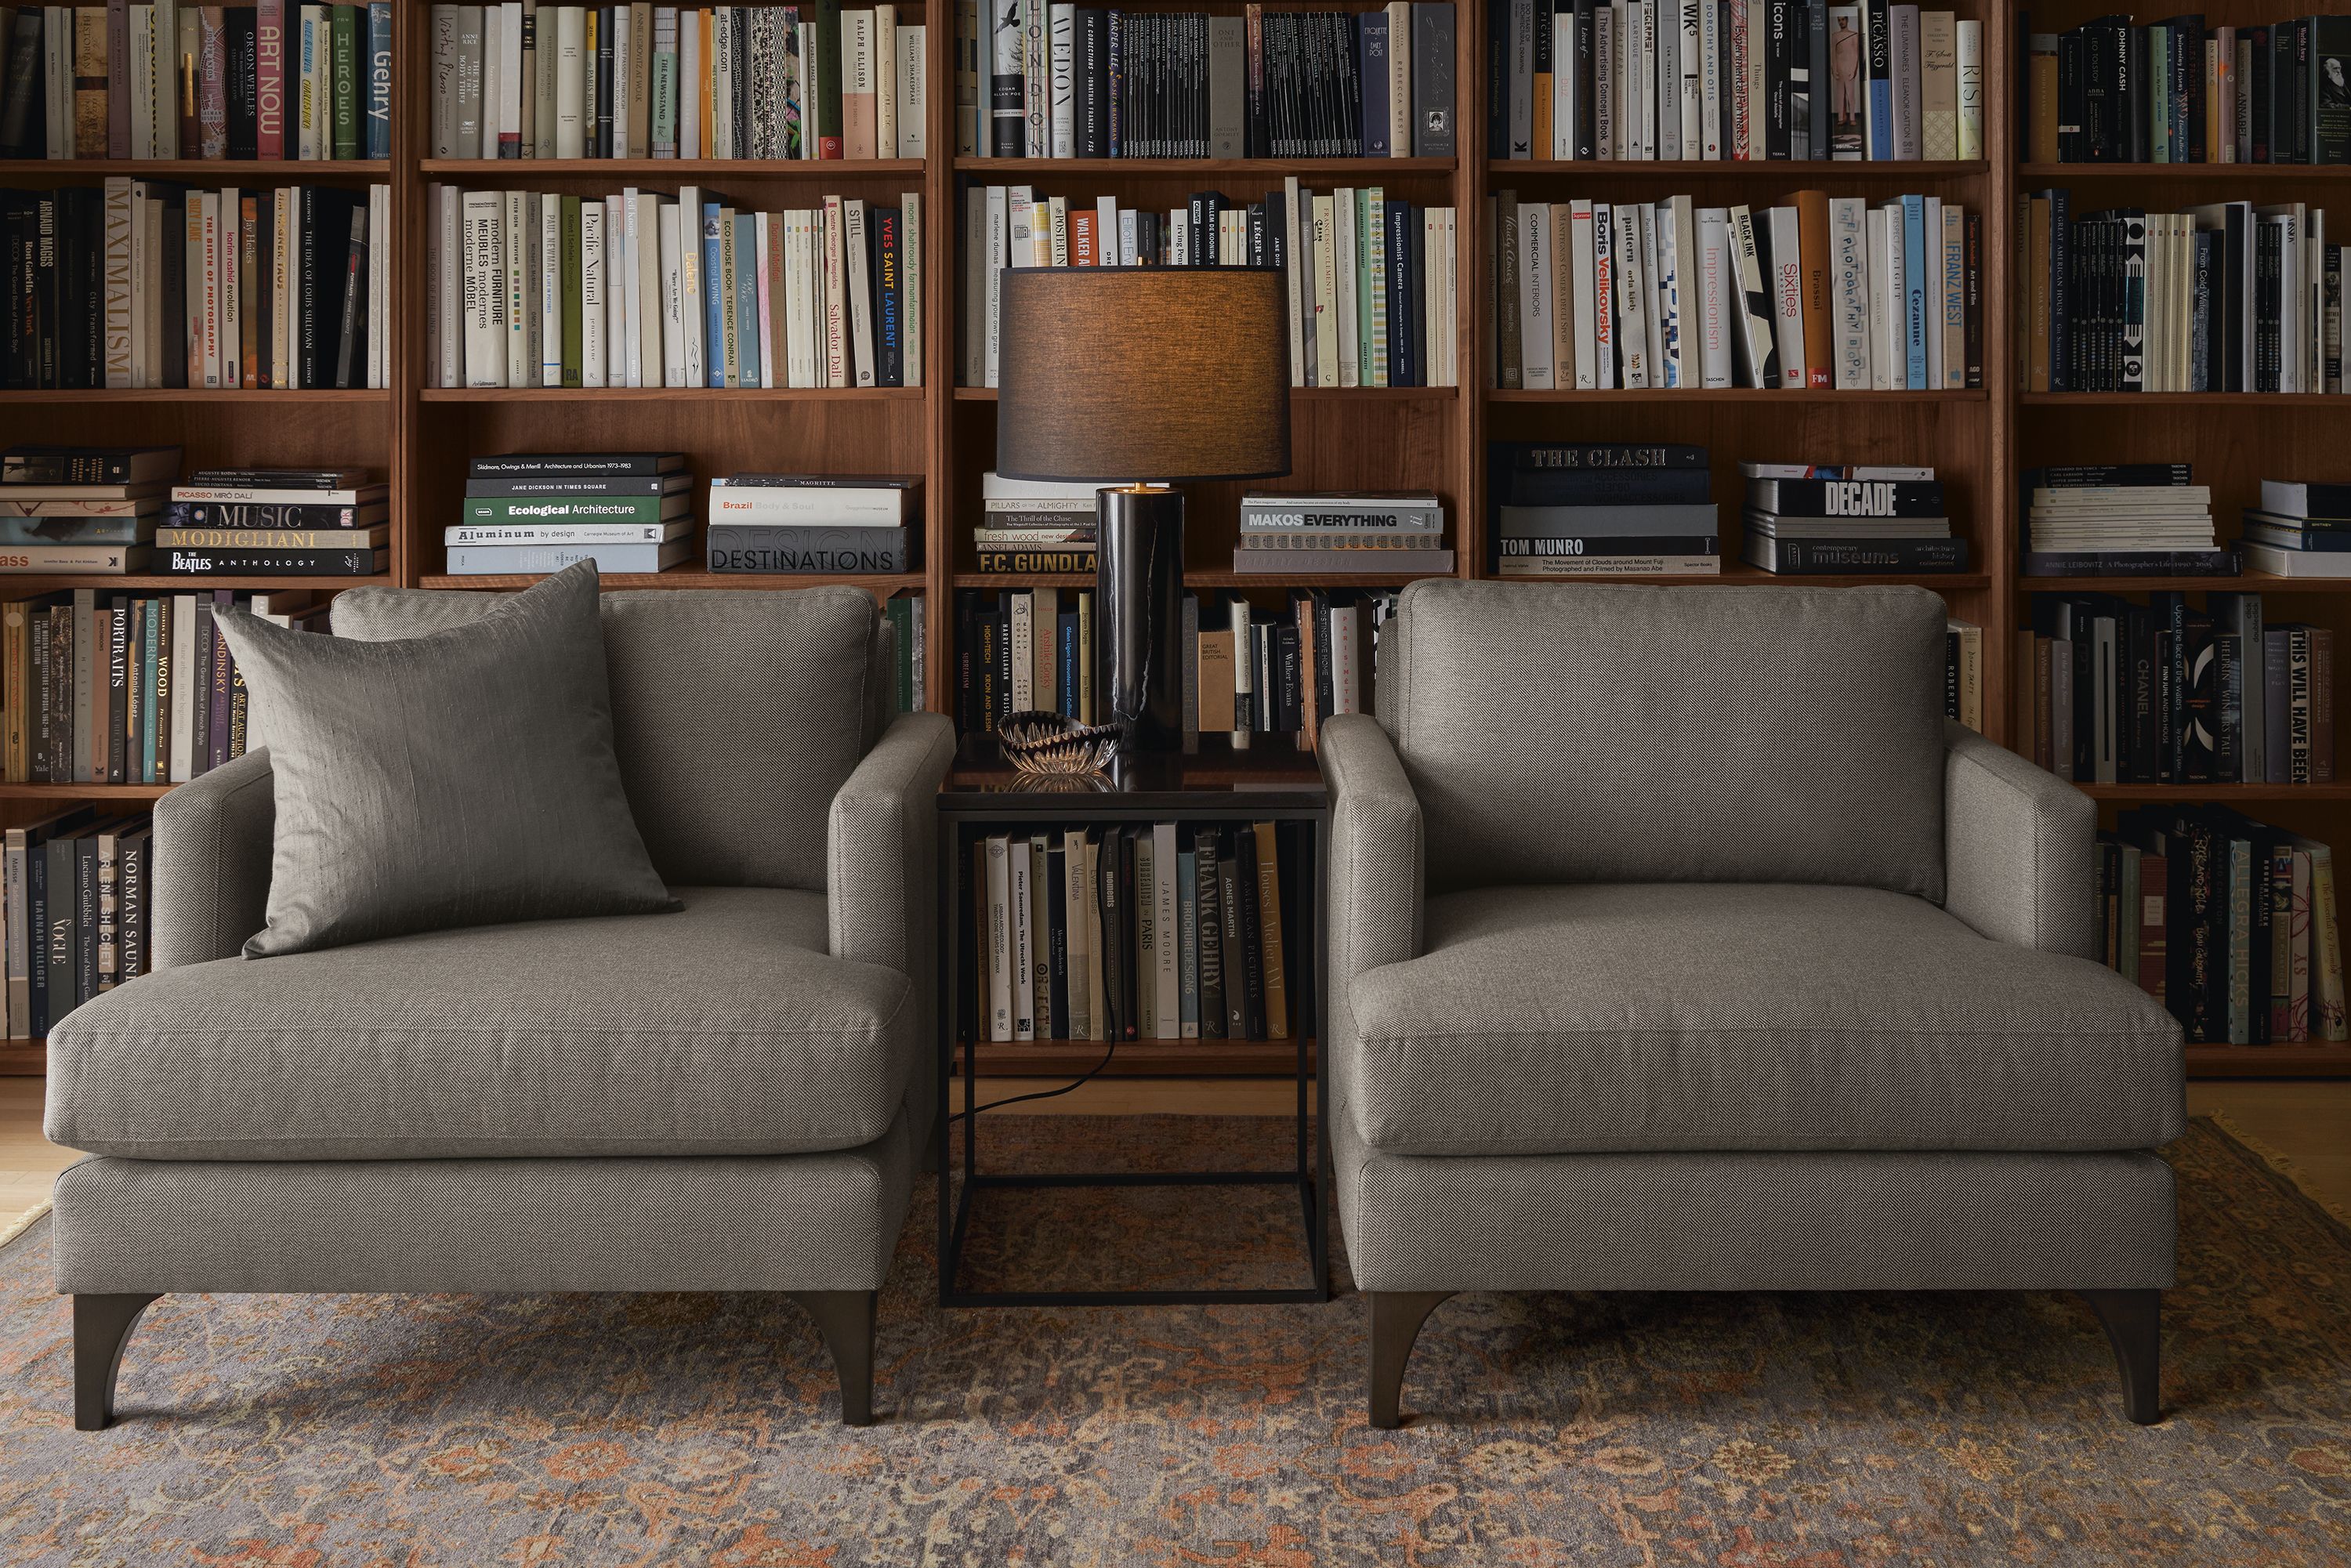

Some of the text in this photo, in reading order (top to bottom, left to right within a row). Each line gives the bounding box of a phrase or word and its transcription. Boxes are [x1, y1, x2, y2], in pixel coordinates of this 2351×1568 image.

[719, 14, 728, 73] at-edge.com
[1364, 27, 1387, 35] ETIQUETTE
[1873, 13, 1885, 67] PICASSO
[259, 26, 281, 136] ART NOW
[338, 34, 350, 125] HEROES
[368, 51, 391, 120] Gehry
[1053, 18, 1070, 106] AVEDON
[1110, 53, 1119, 69] LEE
[1598, 16, 1610, 141] The Advertising Concept Book
[659, 74, 668, 119] NEWSSTAND
[1962, 64, 1981, 118] RISE
[39, 200, 53, 268] ARNAUD MAGGS
[725, 219, 735, 238] ECO
[849, 210, 860, 238] STILL
[1076, 217, 1090, 259] WALKER
[1394, 212, 1403, 260] Impressionist
[1531, 214, 1539, 271] COMMERCIAL
[1622, 217, 1634, 262] pattern
[107, 188, 130, 375] MAXIMALISM
[207, 270, 213, 281] OF
[478, 219, 489, 328] MEUBLES modernes
[491, 219, 502, 326] modern FURNITURE
[585, 214, 600, 304] Pacific Natural
[884, 218, 895, 347] YVES SAINT LAURENT
[1596, 211, 1610, 346] Boris Velikovsky
[466, 276, 477, 313] MÖBEL
[723, 295, 733, 330] TERENCE
[1705, 247, 1720, 351] Impressionism
[1784, 263, 1798, 318] Sixties
[1912, 289, 1922, 346] Cezanne
[723, 333, 734, 367] CONRAN
[829, 303, 843, 379] Salvador Dalí
[1533, 449, 1665, 466] THE CLASH
[218, 505, 302, 528] MUSIC
[509, 505, 635, 516] Ecological Architecture
[1824, 481, 1897, 516] DECADE
[171, 531, 316, 547] MODIGLIANI
[172, 552, 212, 573] BEATLES
[458, 530, 535, 541] Aluminum
[712, 550, 893, 570] DESTINATIONS
[984, 531, 1039, 541] fresh wood
[1500, 539, 1584, 556] TOM MUNRO
[112, 609, 125, 686] PORTRAITS
[146, 608, 157, 663] MODERN
[158, 657, 167, 696] WOOD
[2137, 658, 2149, 719] CHANEL
[2291, 632, 2307, 784] THIS WILL HAVE BEEN
[83, 889, 92, 927] Giubbilei
[101, 851, 111, 968] ARLENE SHECHET
[125, 851, 136, 923] NORMAN
[1161, 882, 1170, 922] JAMES
[53, 919, 67, 964] VOGUE
[1142, 919, 1153, 951] PARIS
[1199, 845, 1221, 991] FRANK GEHRY
[2235, 849, 2249, 1008] ALLEGRA HICKS
